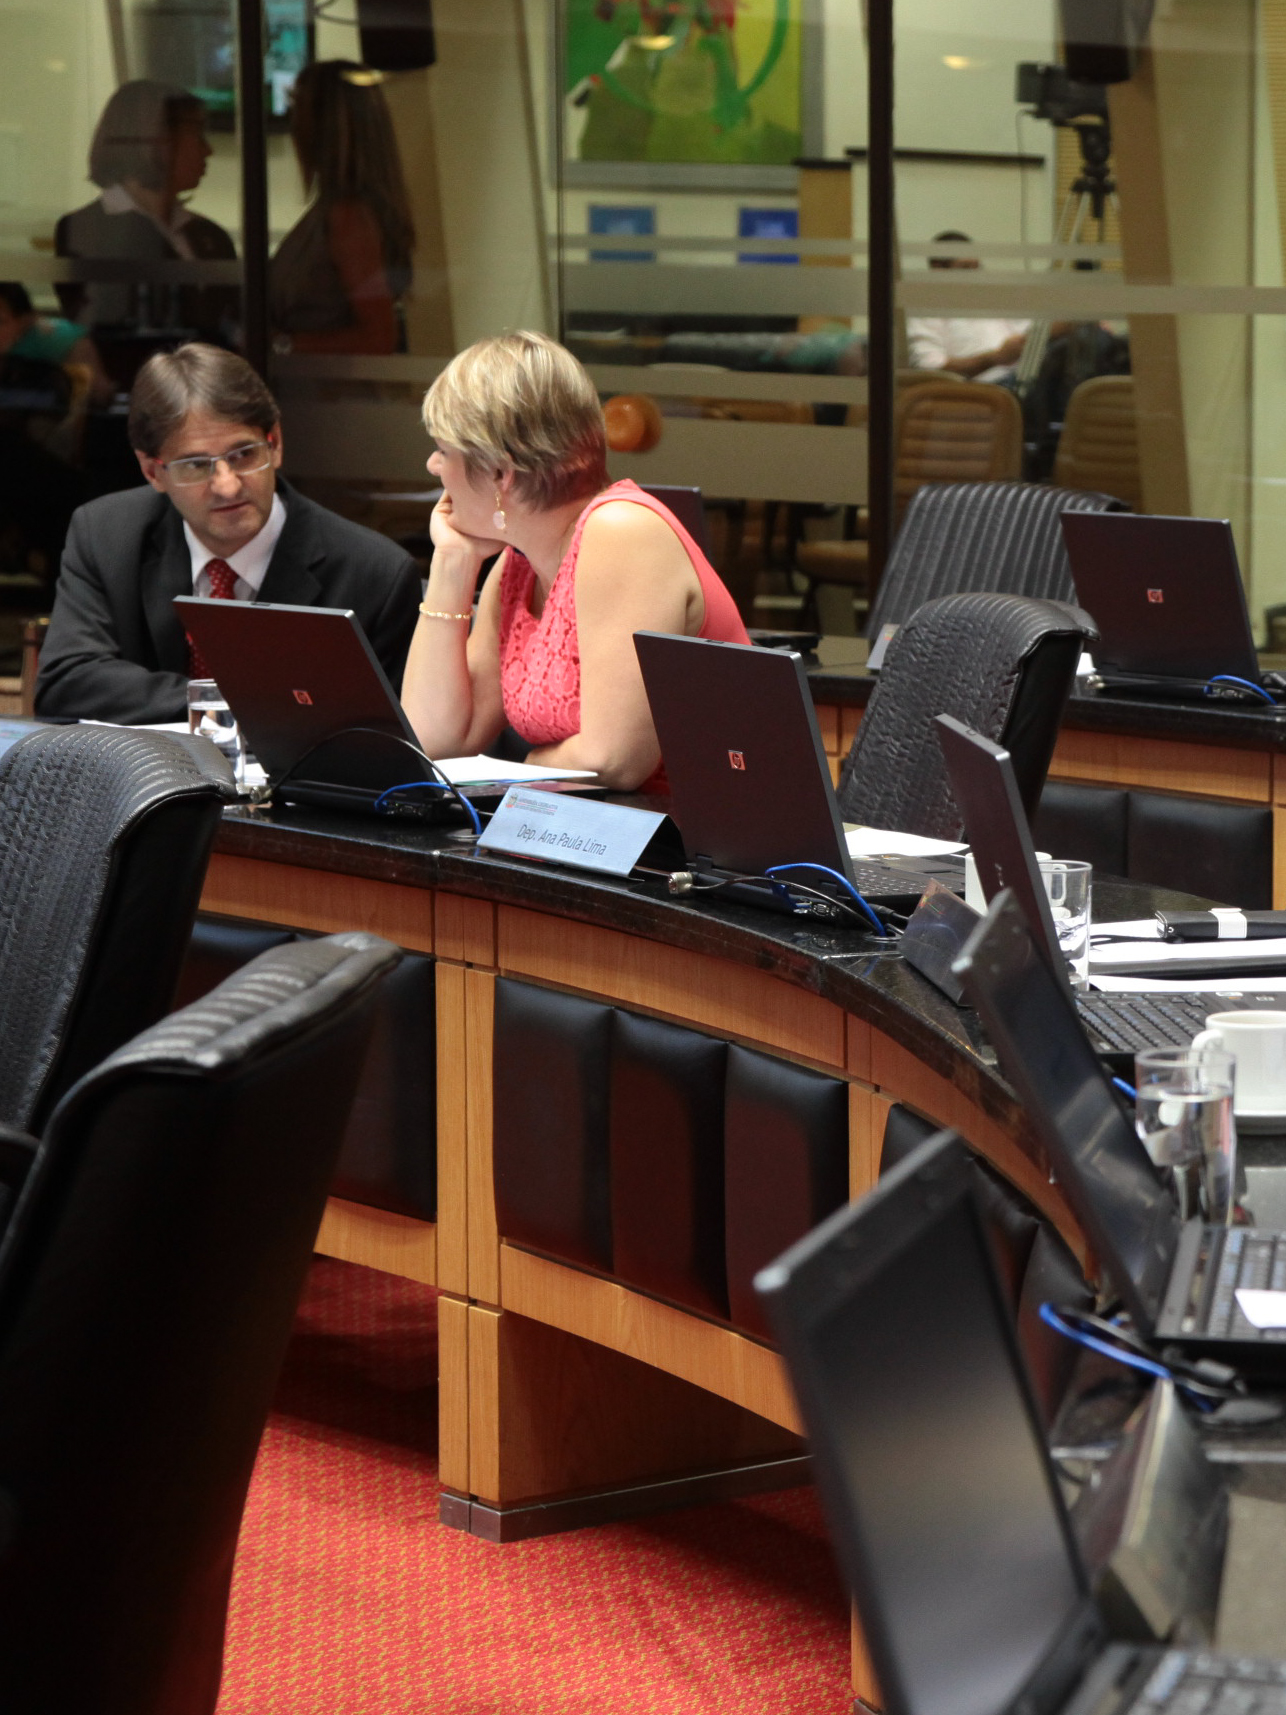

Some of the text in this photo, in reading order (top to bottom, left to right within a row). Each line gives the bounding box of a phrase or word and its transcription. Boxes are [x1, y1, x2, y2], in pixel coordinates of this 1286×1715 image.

[517, 824, 607, 855] Dep. Ana Paula Lima
